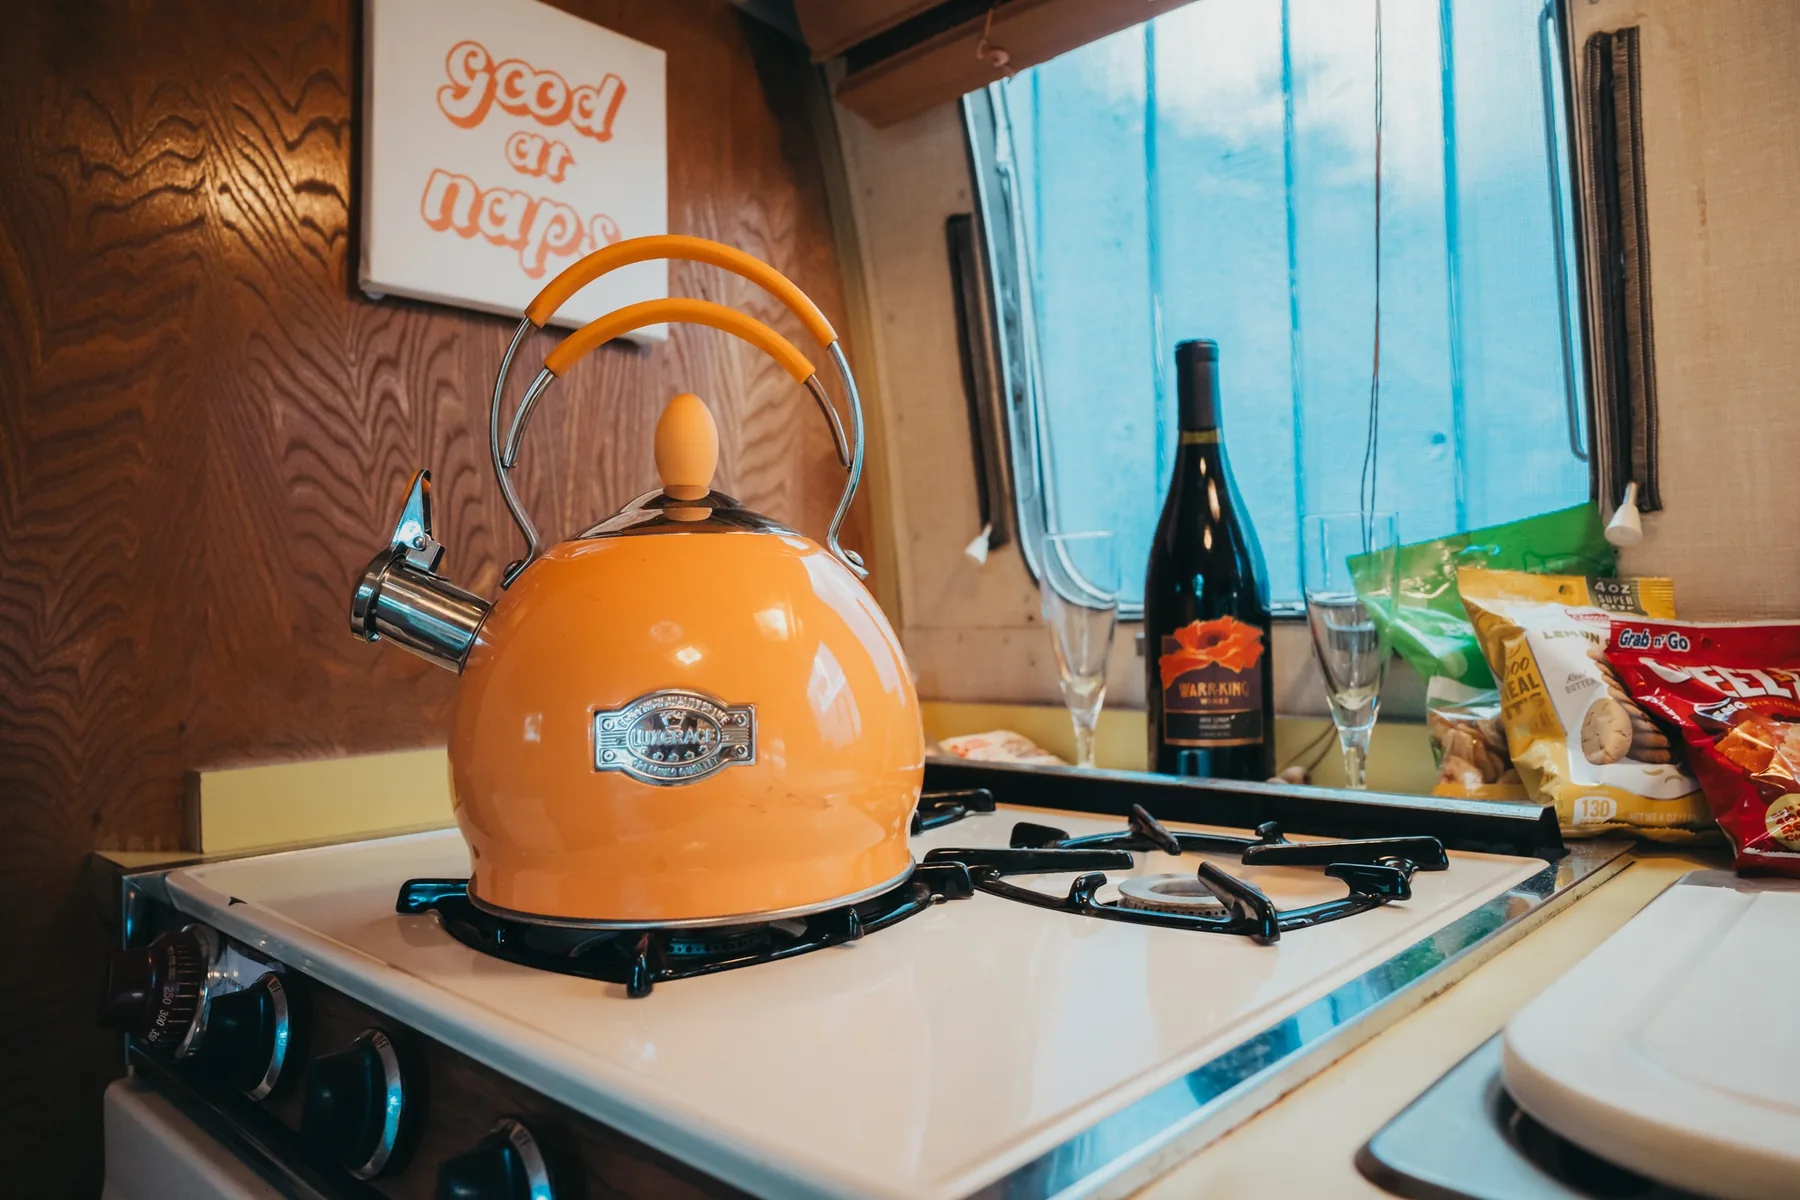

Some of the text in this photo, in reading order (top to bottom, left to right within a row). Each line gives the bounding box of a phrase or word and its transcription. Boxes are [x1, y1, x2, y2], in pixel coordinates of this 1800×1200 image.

[437, 40, 627, 142] good
[505, 131, 576, 183] at
[1598, 594, 1634, 605] SUPER
[1543, 630, 1600, 645] LEMON
[1619, 629, 1650, 648] Grab
[1667, 632, 1690, 652] Go
[1505, 673, 1540, 702] EAL
[1581, 799, 1611, 817] 130
[162, 985, 175, 1005] 250
[156, 1009, 169, 1027] 300
[147, 1028, 160, 1042] 350
